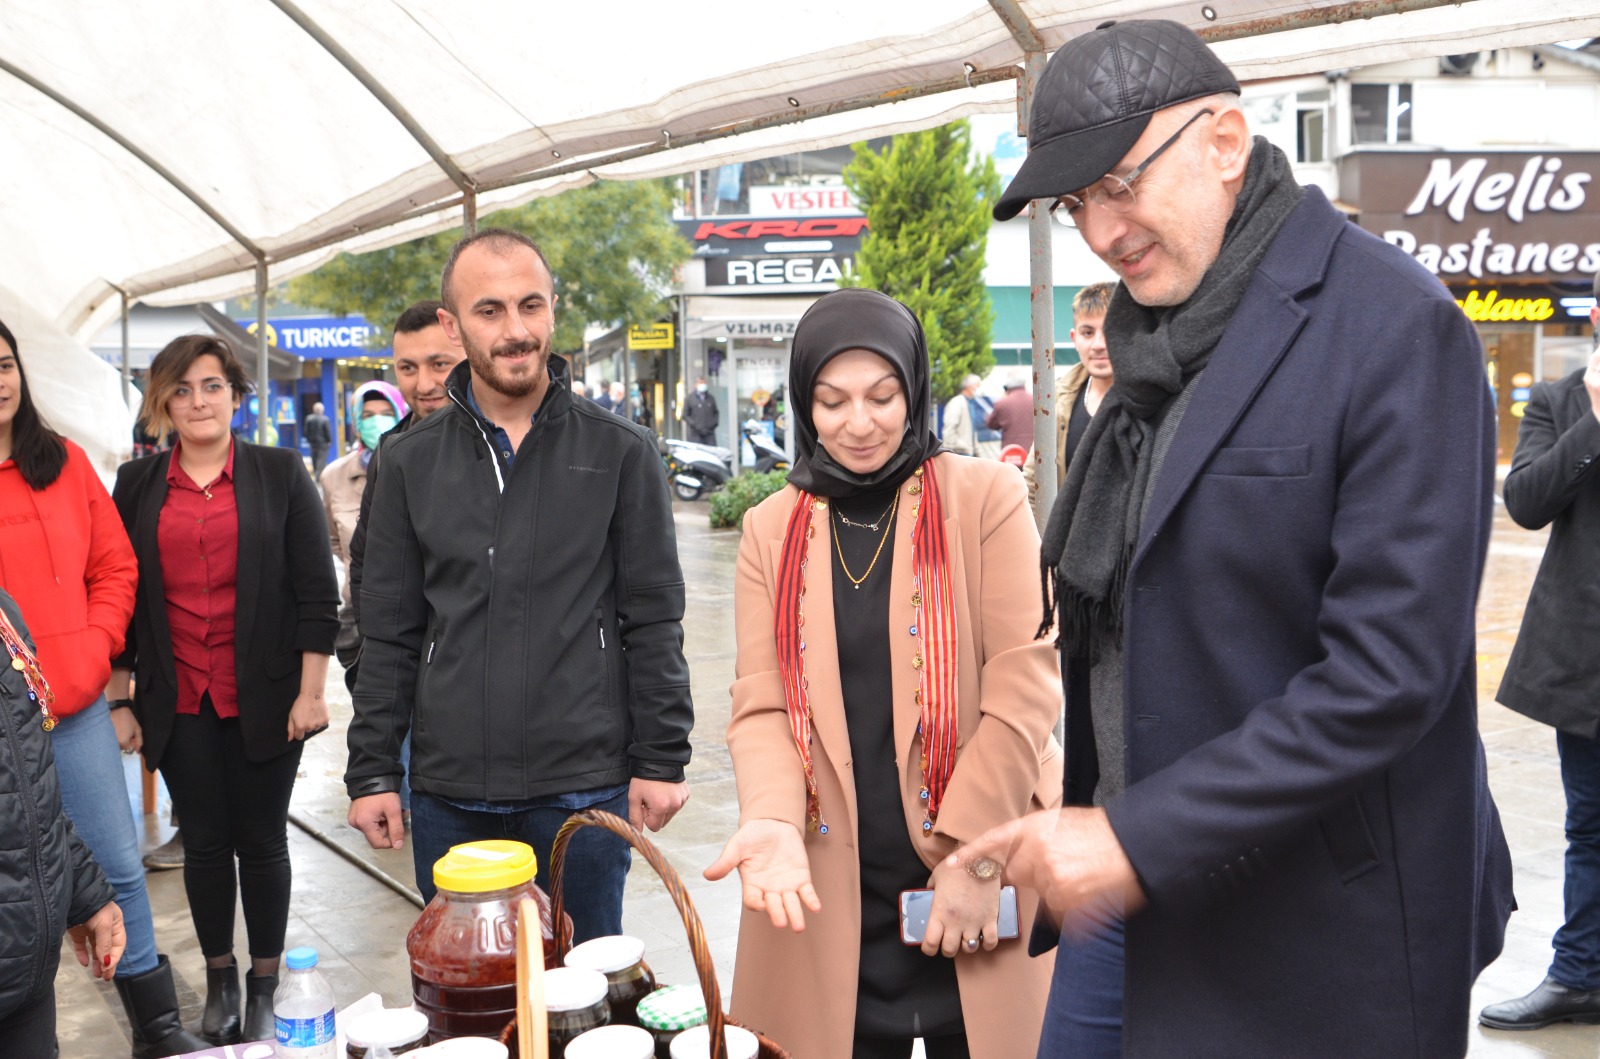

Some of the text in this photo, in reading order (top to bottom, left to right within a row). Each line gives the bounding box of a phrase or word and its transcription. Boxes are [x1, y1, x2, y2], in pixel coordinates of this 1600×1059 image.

[1406, 156, 1592, 222] Melis
[727, 258, 861, 285] REGAL
[1455, 290, 1554, 321] klava
